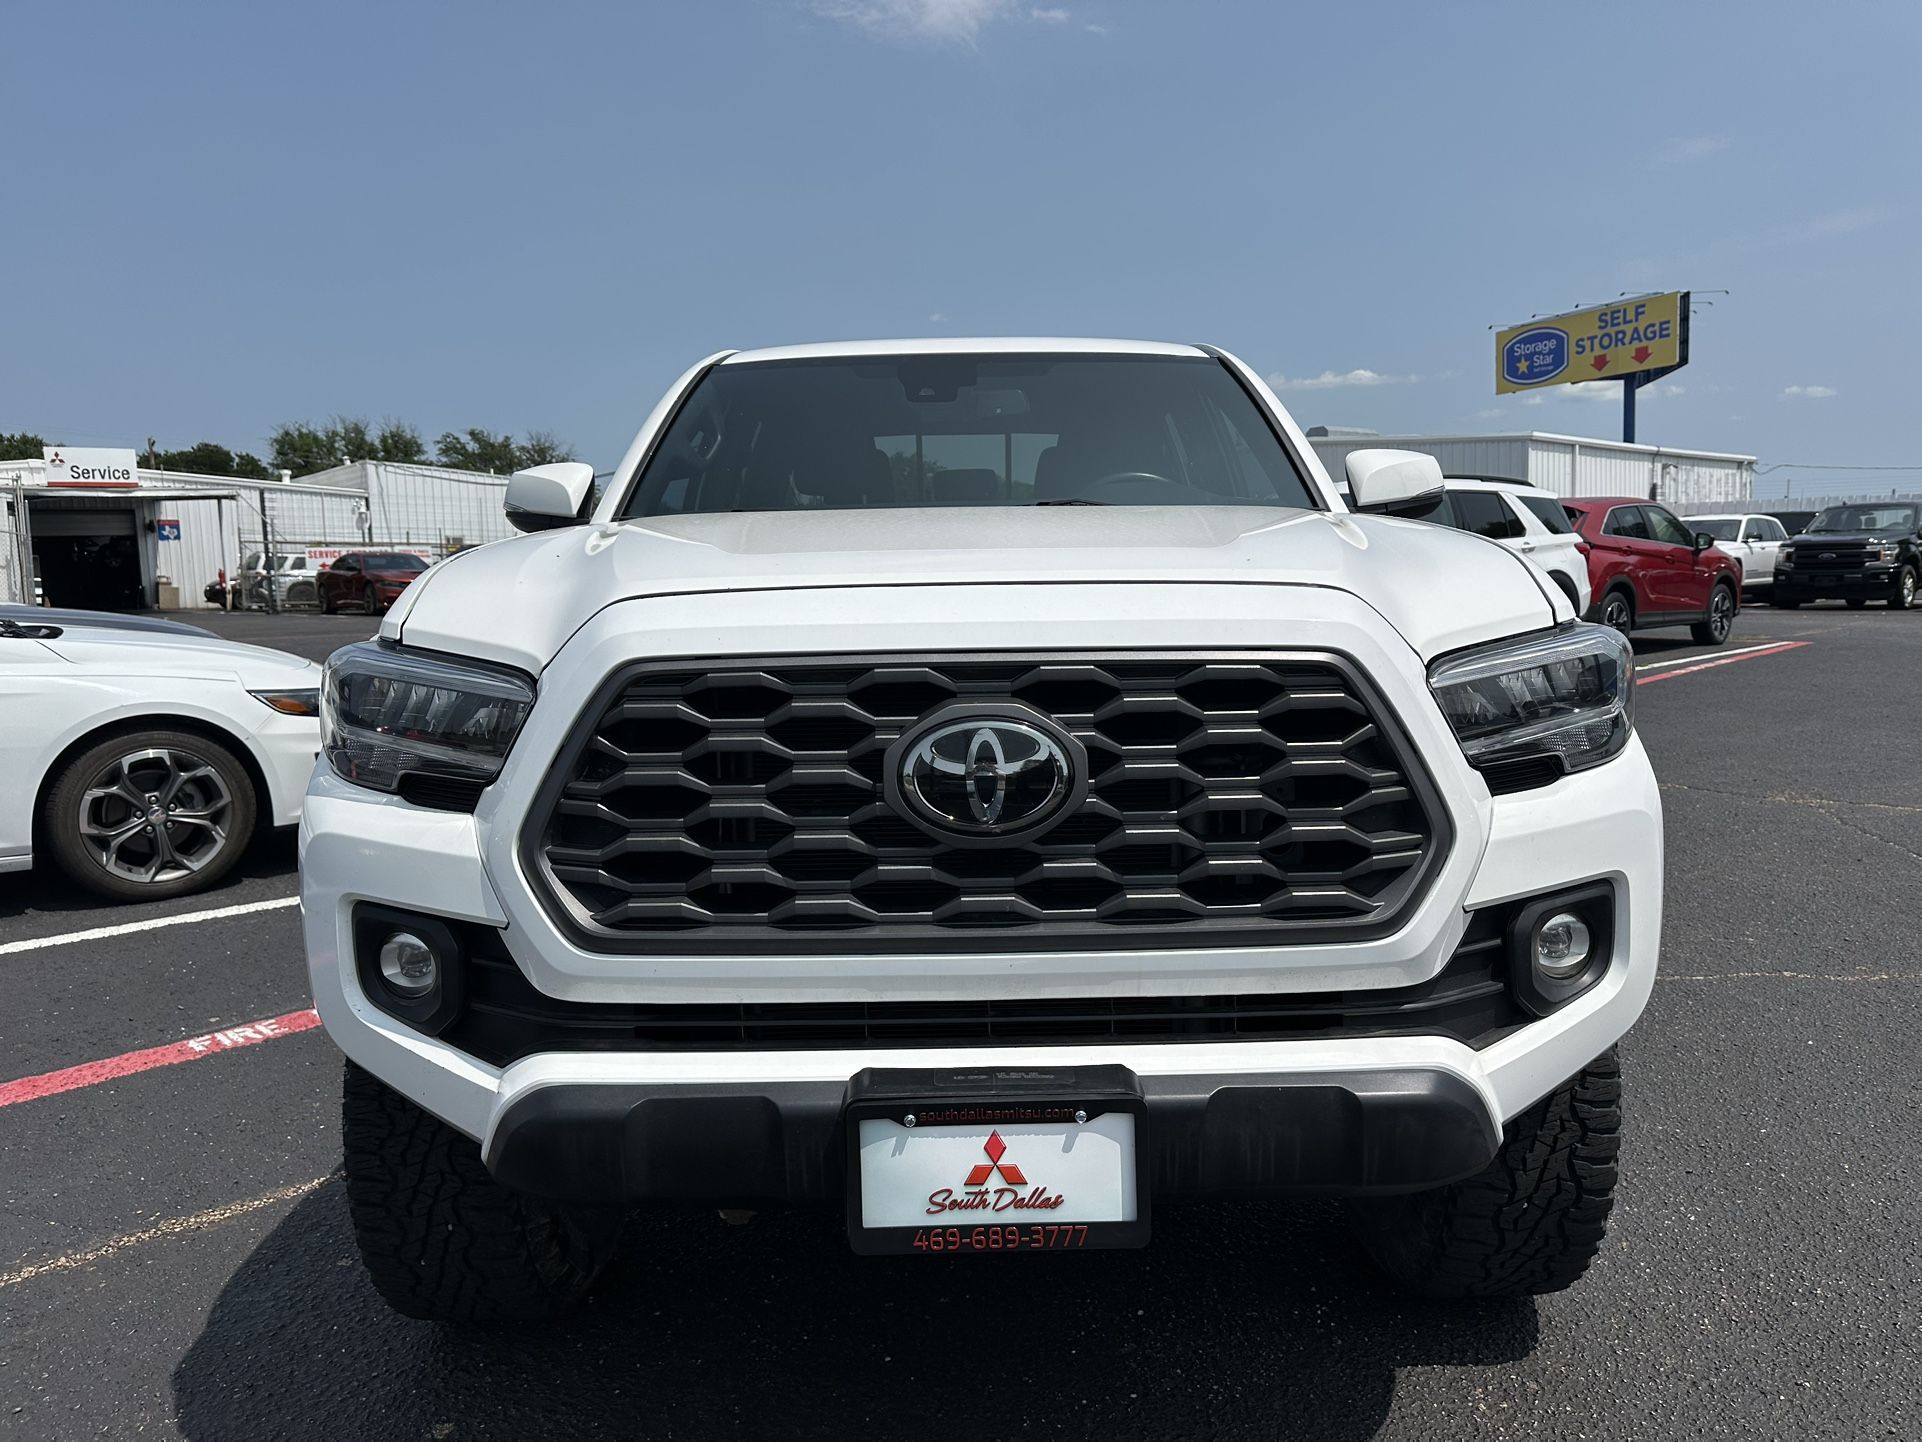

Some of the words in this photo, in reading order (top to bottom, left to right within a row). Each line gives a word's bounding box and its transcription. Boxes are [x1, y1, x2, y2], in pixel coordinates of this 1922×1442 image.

[1597, 303, 1646, 330] SELF
[1513, 339, 1557, 356] Storage
[1575, 320, 1671, 355] STORAGE
[1533, 354, 1554, 366] Star
[70, 465, 130, 480] Service
[188, 1019, 288, 1052] FIRE
[919, 1107, 1075, 1122] southdallasmitsu.com
[926, 1188, 991, 1214] South
[992, 1186, 1065, 1212] Dallas
[913, 1225, 1088, 1250] 469-689-3777
